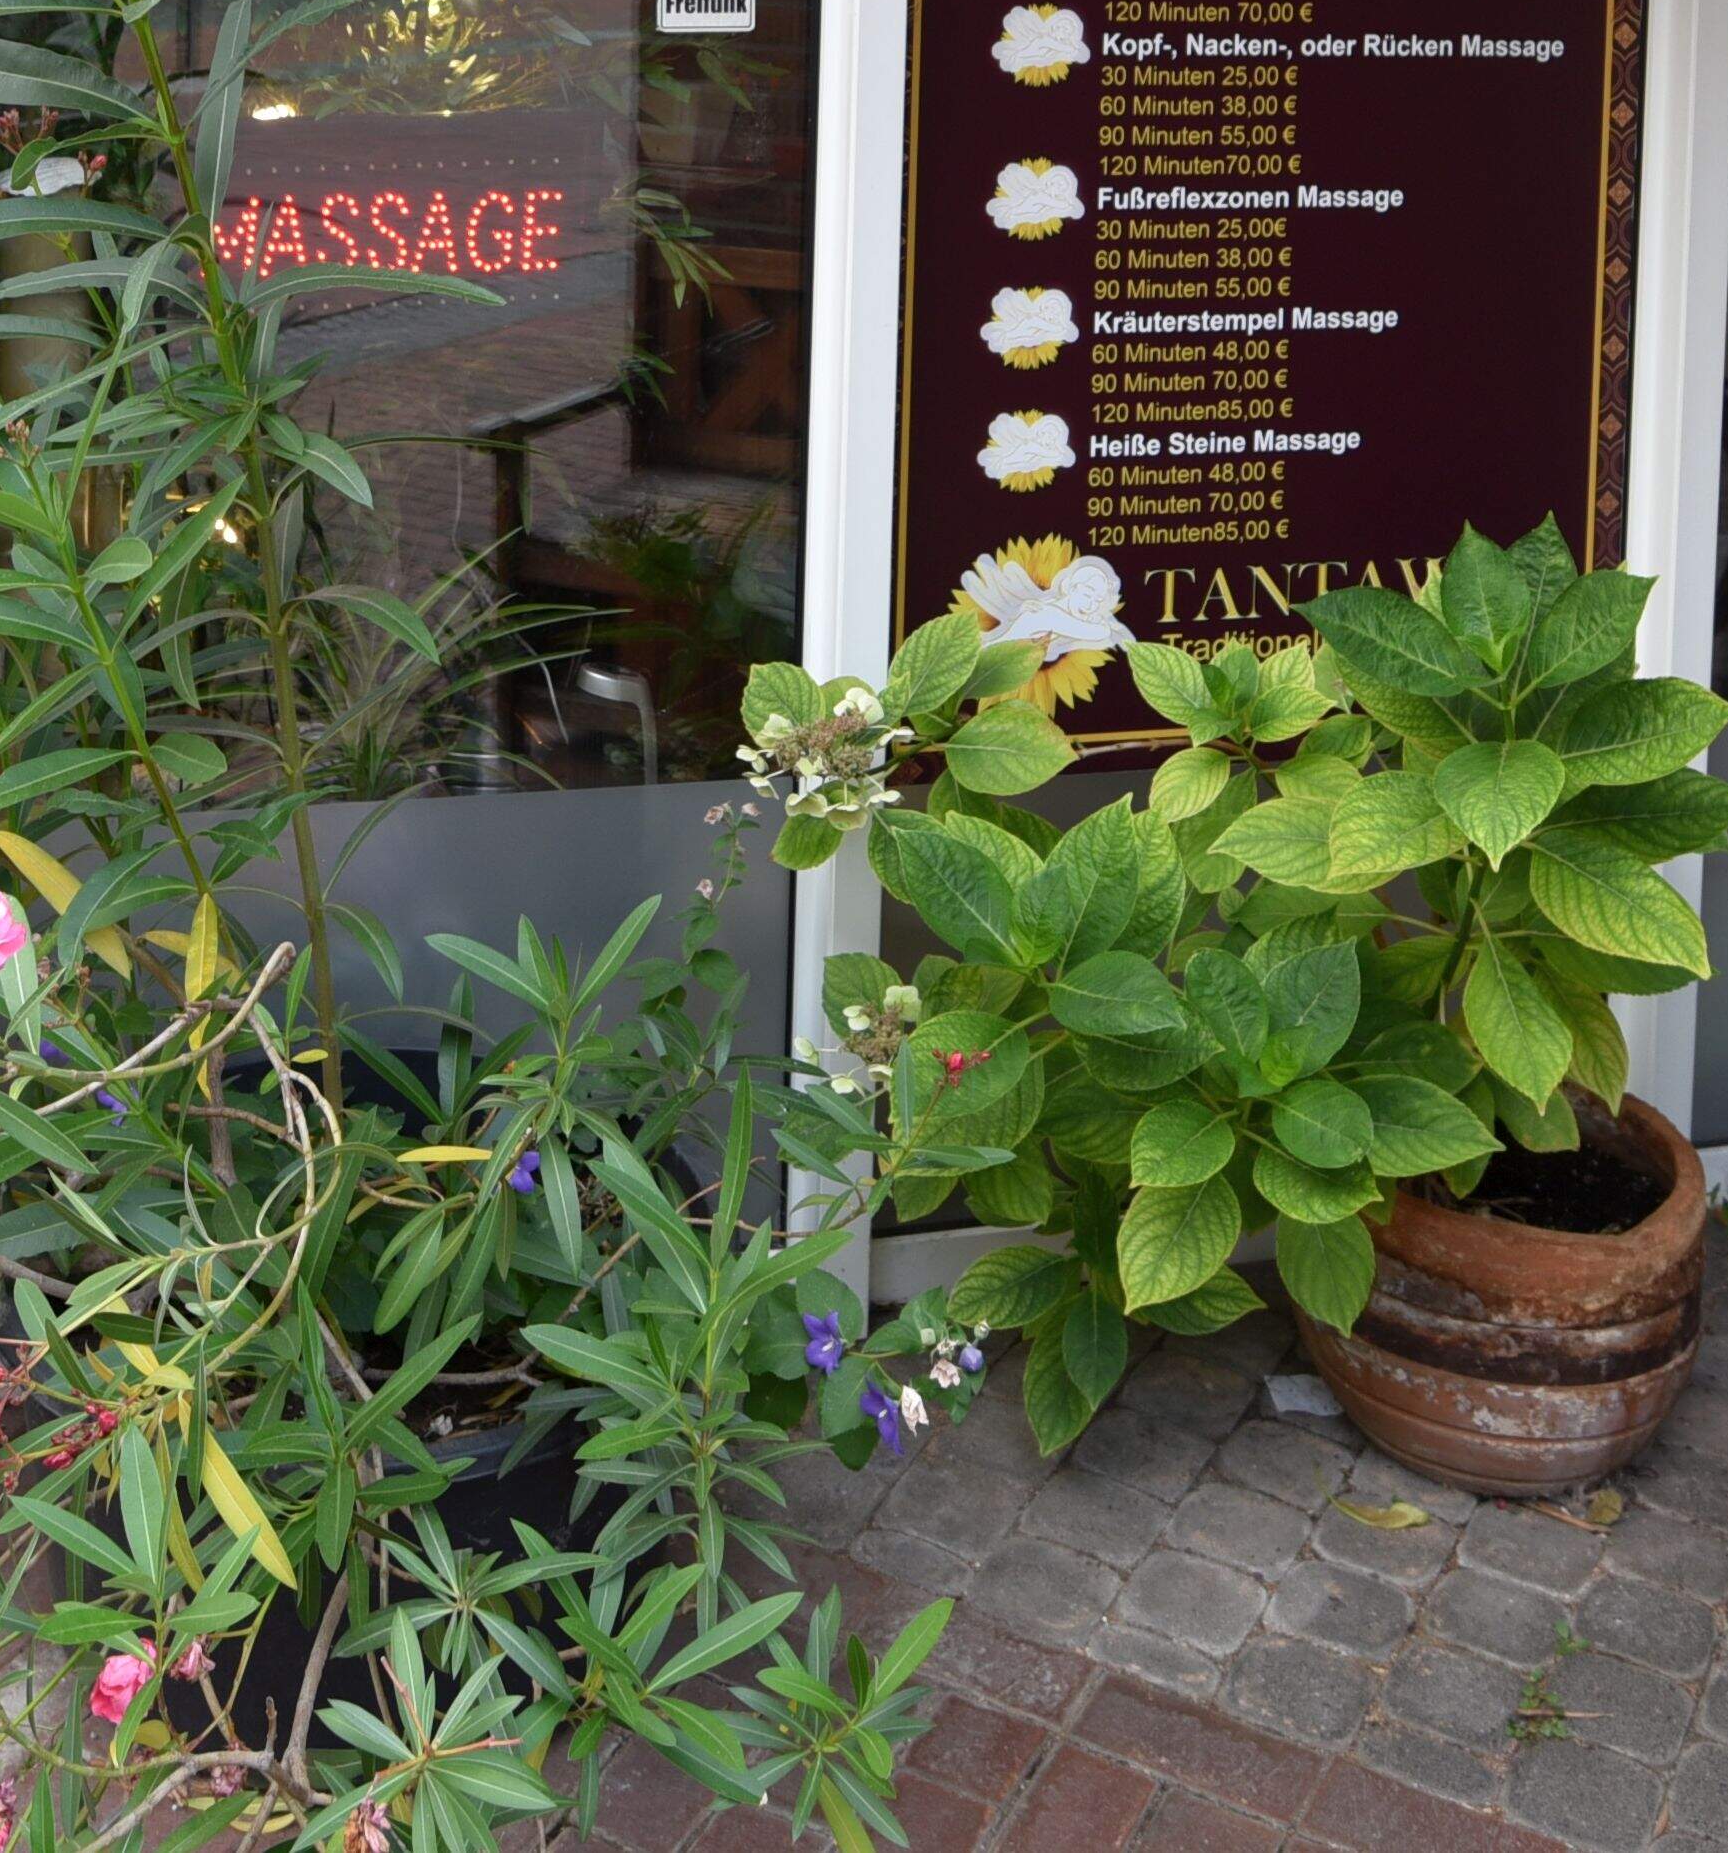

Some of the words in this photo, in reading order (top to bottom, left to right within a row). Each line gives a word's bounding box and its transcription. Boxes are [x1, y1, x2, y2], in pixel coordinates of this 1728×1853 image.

[1105, 1, 1141, 21] 120
[1149, 1, 1229, 22] Minuten
[1238, 2, 1293, 25] 70,00
[1299, 2, 1313, 22] €
[1102, 33, 1177, 61] Kopf-,
[1186, 33, 1292, 60] Nacken-,
[1300, 34, 1357, 56] oder
[1363, 34, 1453, 57] Rücken
[1461, 34, 1564, 62] Massage
[1101, 66, 1126, 86] 30
[1134, 66, 1214, 86] Minuten
[1222, 66, 1279, 88] 25,00
[1284, 66, 1298, 86] €
[1100, 96, 1125, 115] 60
[1133, 95, 1213, 115] Minuten
[1222, 95, 1278, 117] 38,00
[1284, 95, 1297, 115] €
[1099, 126, 1124, 146] 90
[1132, 126, 1213, 145] Minuten
[1221, 125, 1277, 148] 55,00
[1282, 125, 1296, 145] €
[1100, 155, 1136, 176] 120
[1288, 154, 1301, 174] €
[1097, 186, 1289, 210] Fußreflexzonen
[1297, 185, 1404, 213] Massage
[202, 190, 564, 276] MASSAGE
[1096, 220, 1121, 240] 30
[1129, 220, 1209, 239] Minuten
[1095, 250, 1120, 270] 60
[1128, 249, 1209, 269] Minuten
[1217, 247, 1272, 270] 38,00
[1278, 247, 1292, 266] €
[1094, 280, 1119, 300] 90
[1127, 279, 1208, 299] Minuten
[1215, 277, 1271, 299] 55,00
[1277, 276, 1291, 296] €
[1094, 307, 1284, 336] Kräuterstempel
[1292, 307, 1398, 333] Massage
[1092, 344, 1117, 364] 60
[1126, 343, 1206, 362] Minuten
[1212, 340, 1269, 362] 48,00
[1275, 339, 1289, 359] €
[1091, 373, 1117, 394] 90
[1124, 373, 1205, 392] Minuten
[1213, 369, 1268, 392] 70,00
[1274, 368, 1288, 388] €
[1092, 403, 1129, 423] 120
[1279, 398, 1293, 418] €
[1090, 434, 1161, 458] Heiße
[1168, 431, 1246, 455] Steine
[1253, 429, 1361, 455] Massage
[1088, 467, 1113, 487] 60
[1122, 466, 1201, 485] Minuten
[1208, 461, 1265, 484] 48,00
[1271, 460, 1285, 480] €
[1087, 497, 1113, 517] 90
[1120, 495, 1201, 515] Minuten
[1209, 491, 1264, 514] 70,00
[1270, 490, 1284, 510] €
[1088, 526, 1125, 546] 120
[1275, 518, 1289, 538] €
[1144, 556, 1448, 624] TANT
